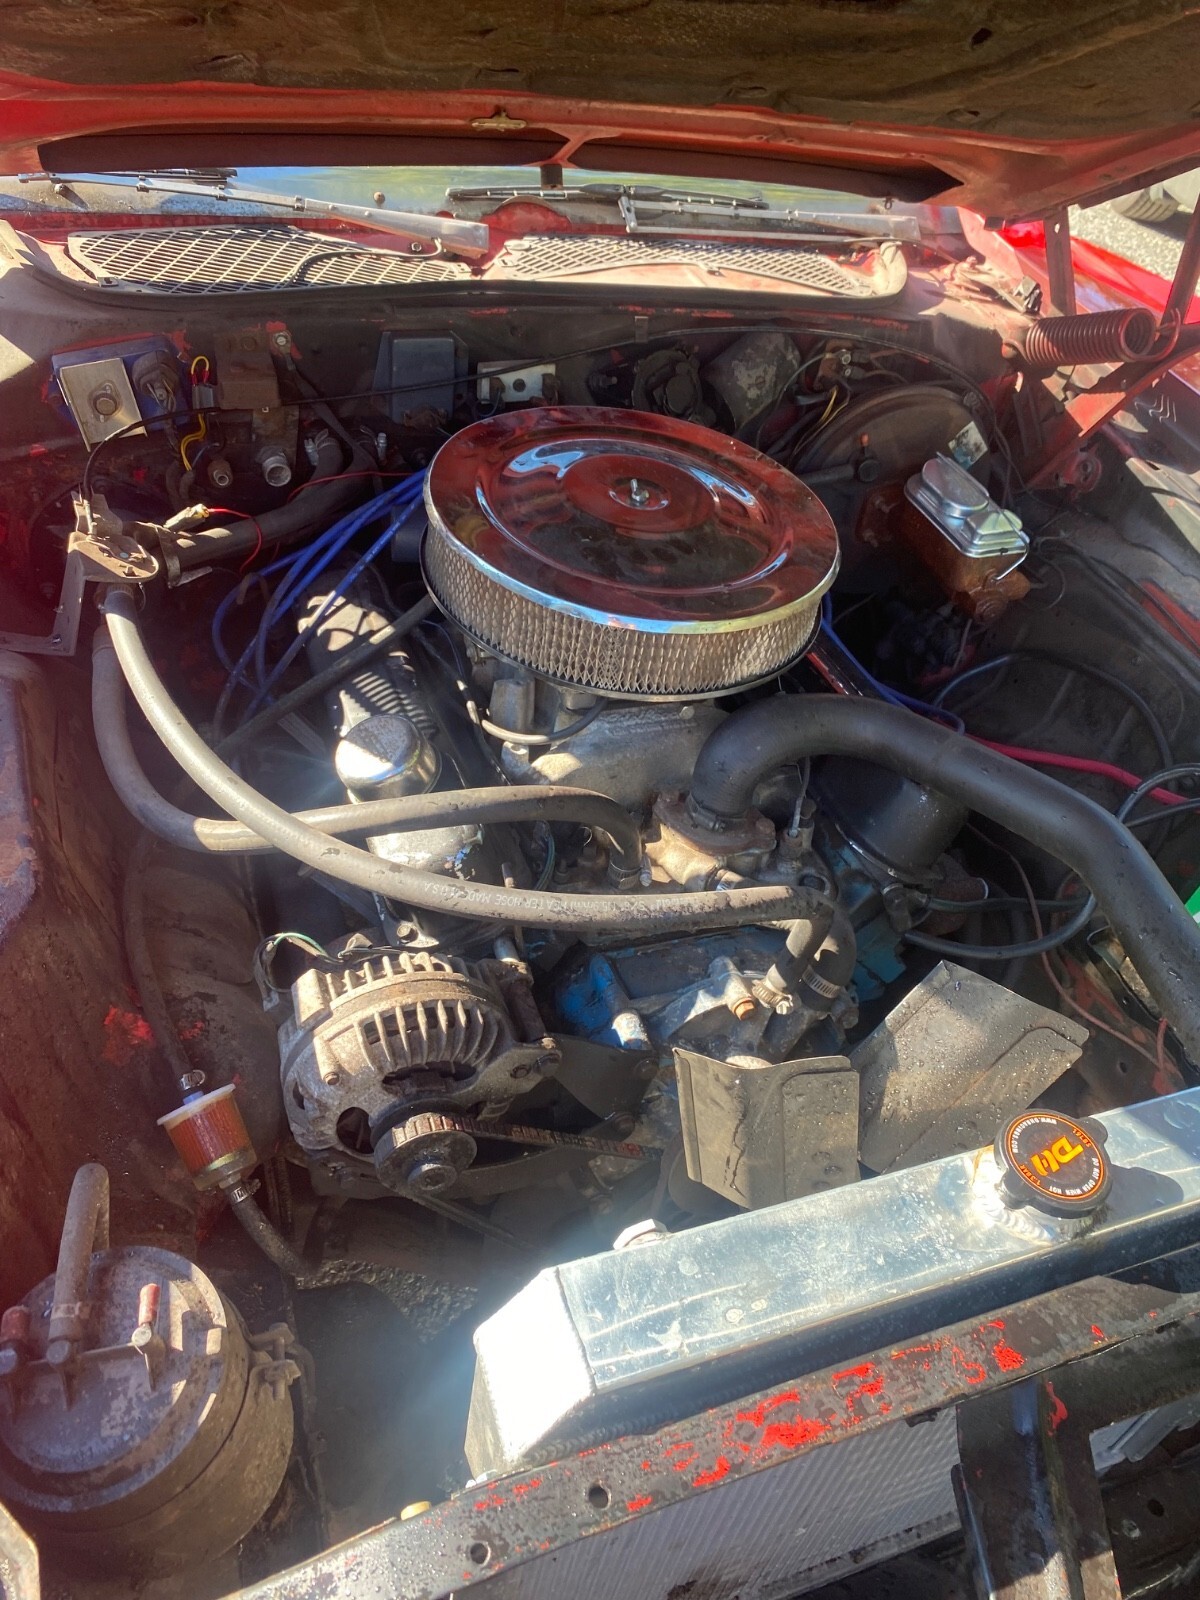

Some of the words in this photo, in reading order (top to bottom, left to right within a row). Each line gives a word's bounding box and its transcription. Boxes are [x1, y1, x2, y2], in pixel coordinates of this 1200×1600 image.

[494, 894, 522, 907] HOSE
[524, 898, 568, 911] HEATER
[1091, 1157, 1100, 1167] DO
[1091, 1167, 1100, 1180] NOT
[1049, 1185, 1062, 1194] HOT
[1064, 1188, 1083, 1196] WHEN
[1081, 1179, 1096, 1193] OPEN
